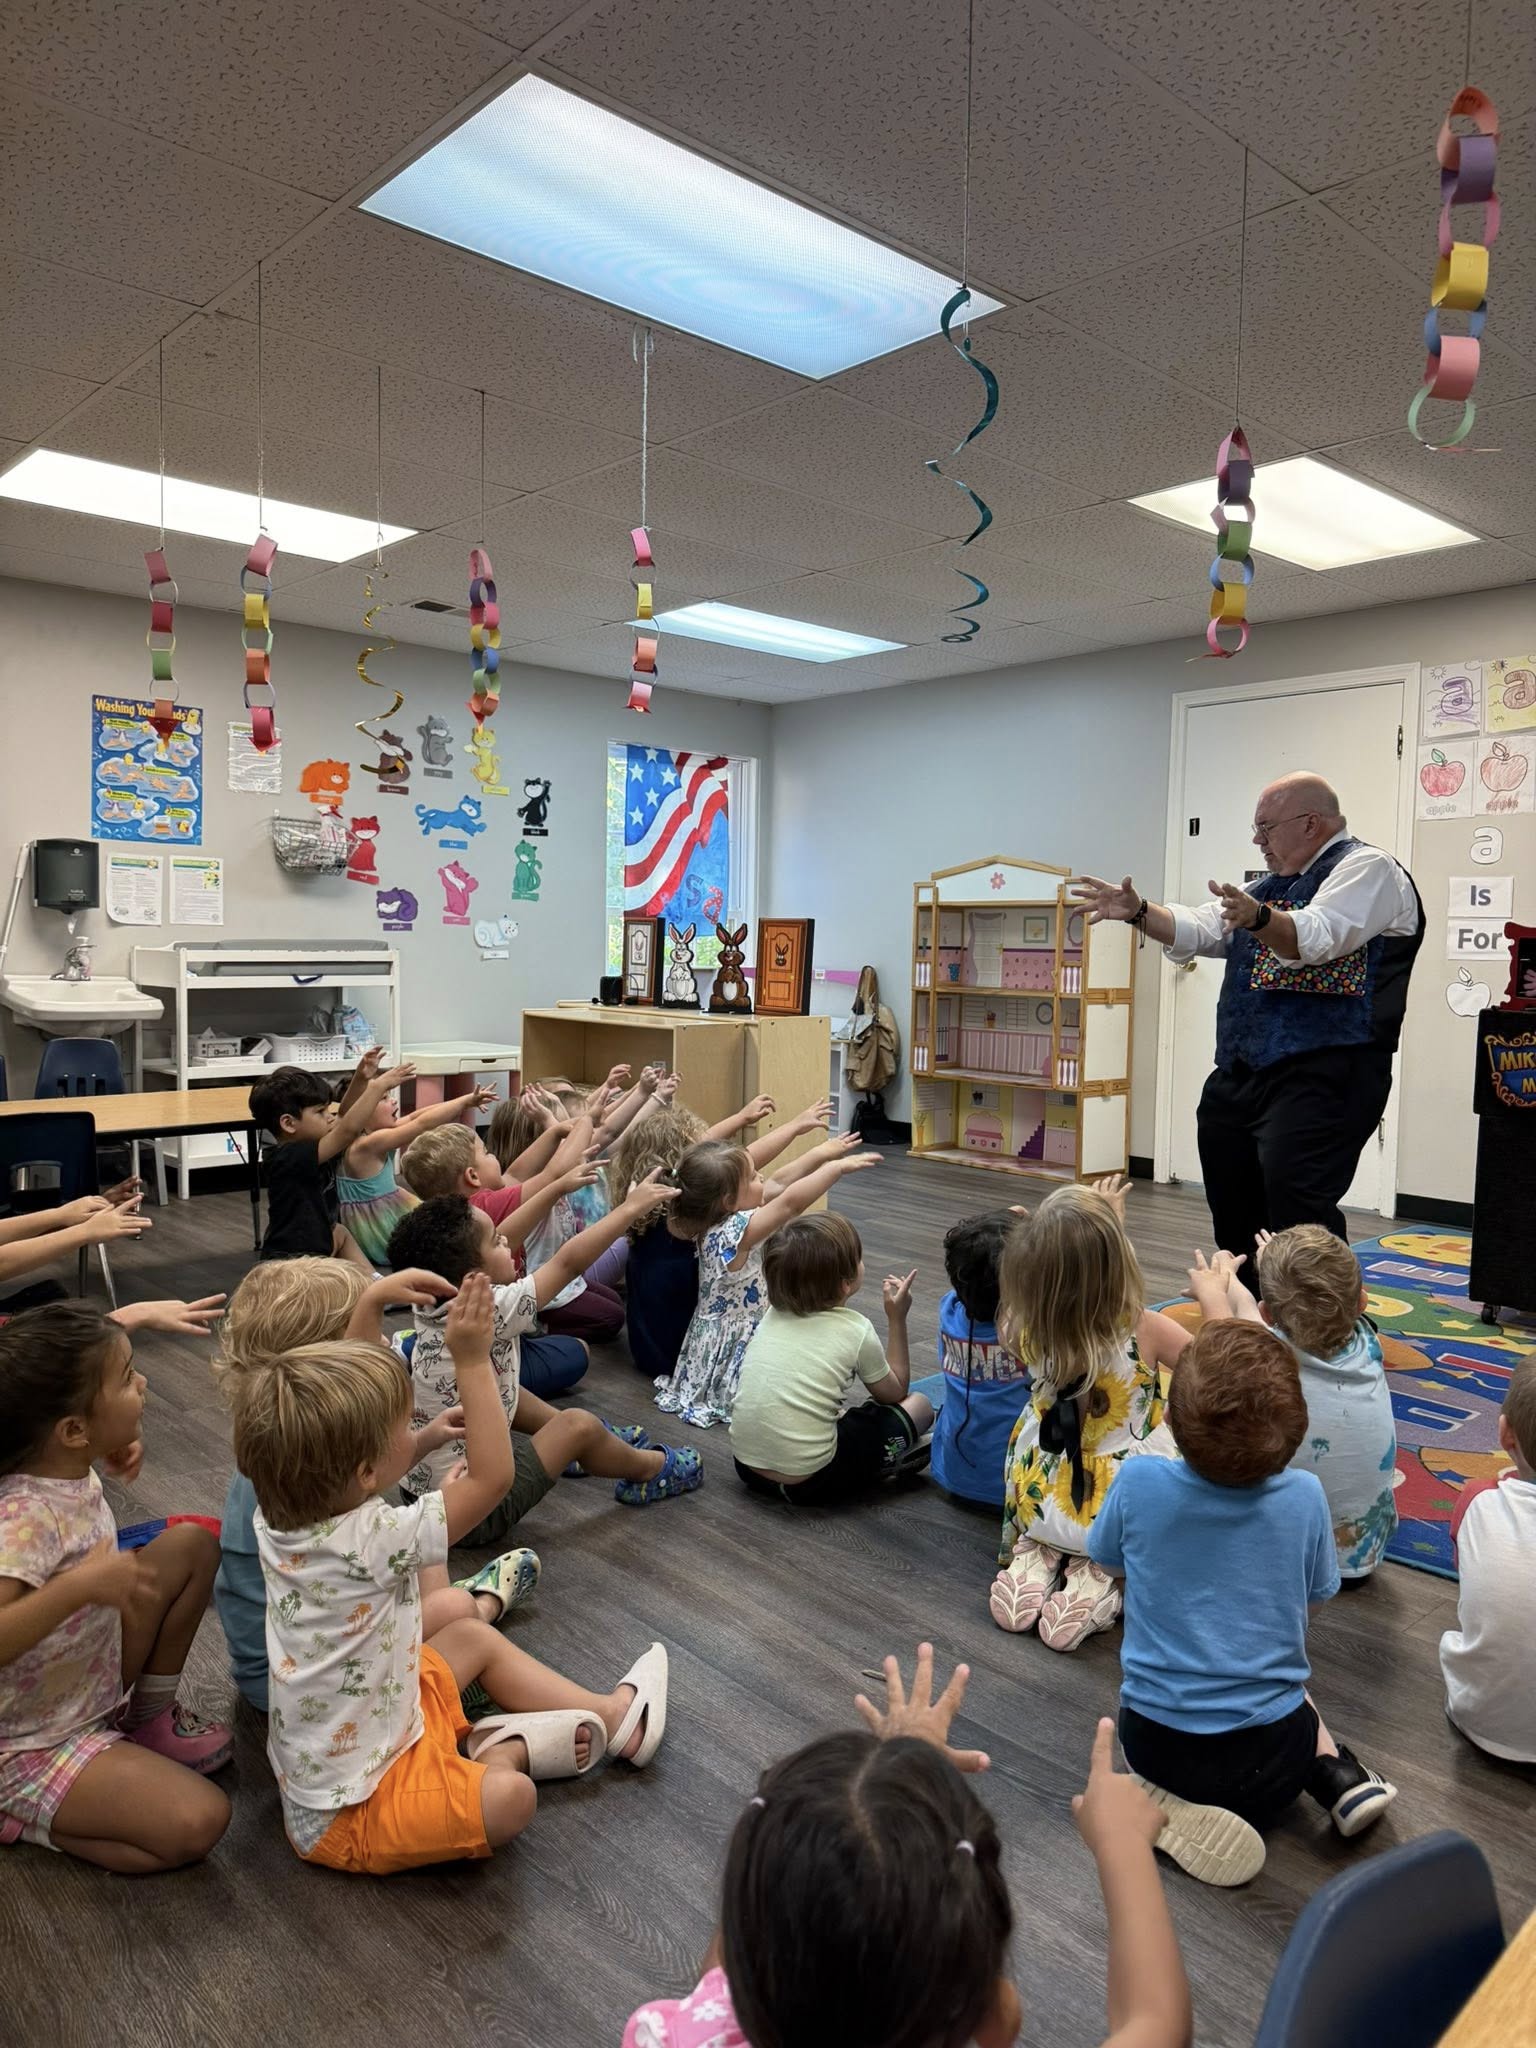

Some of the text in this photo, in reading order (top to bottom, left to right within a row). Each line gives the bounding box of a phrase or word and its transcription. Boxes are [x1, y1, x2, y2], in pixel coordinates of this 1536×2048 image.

[1441, 676, 1473, 715] a
[1503, 669, 1536, 709] a
[96, 697, 135, 718] Washing
[1426, 803, 1457, 816] apple
[1470, 826, 1503, 865] a
[1470, 885, 1491, 907] Is
[1457, 928, 1502, 950] For
